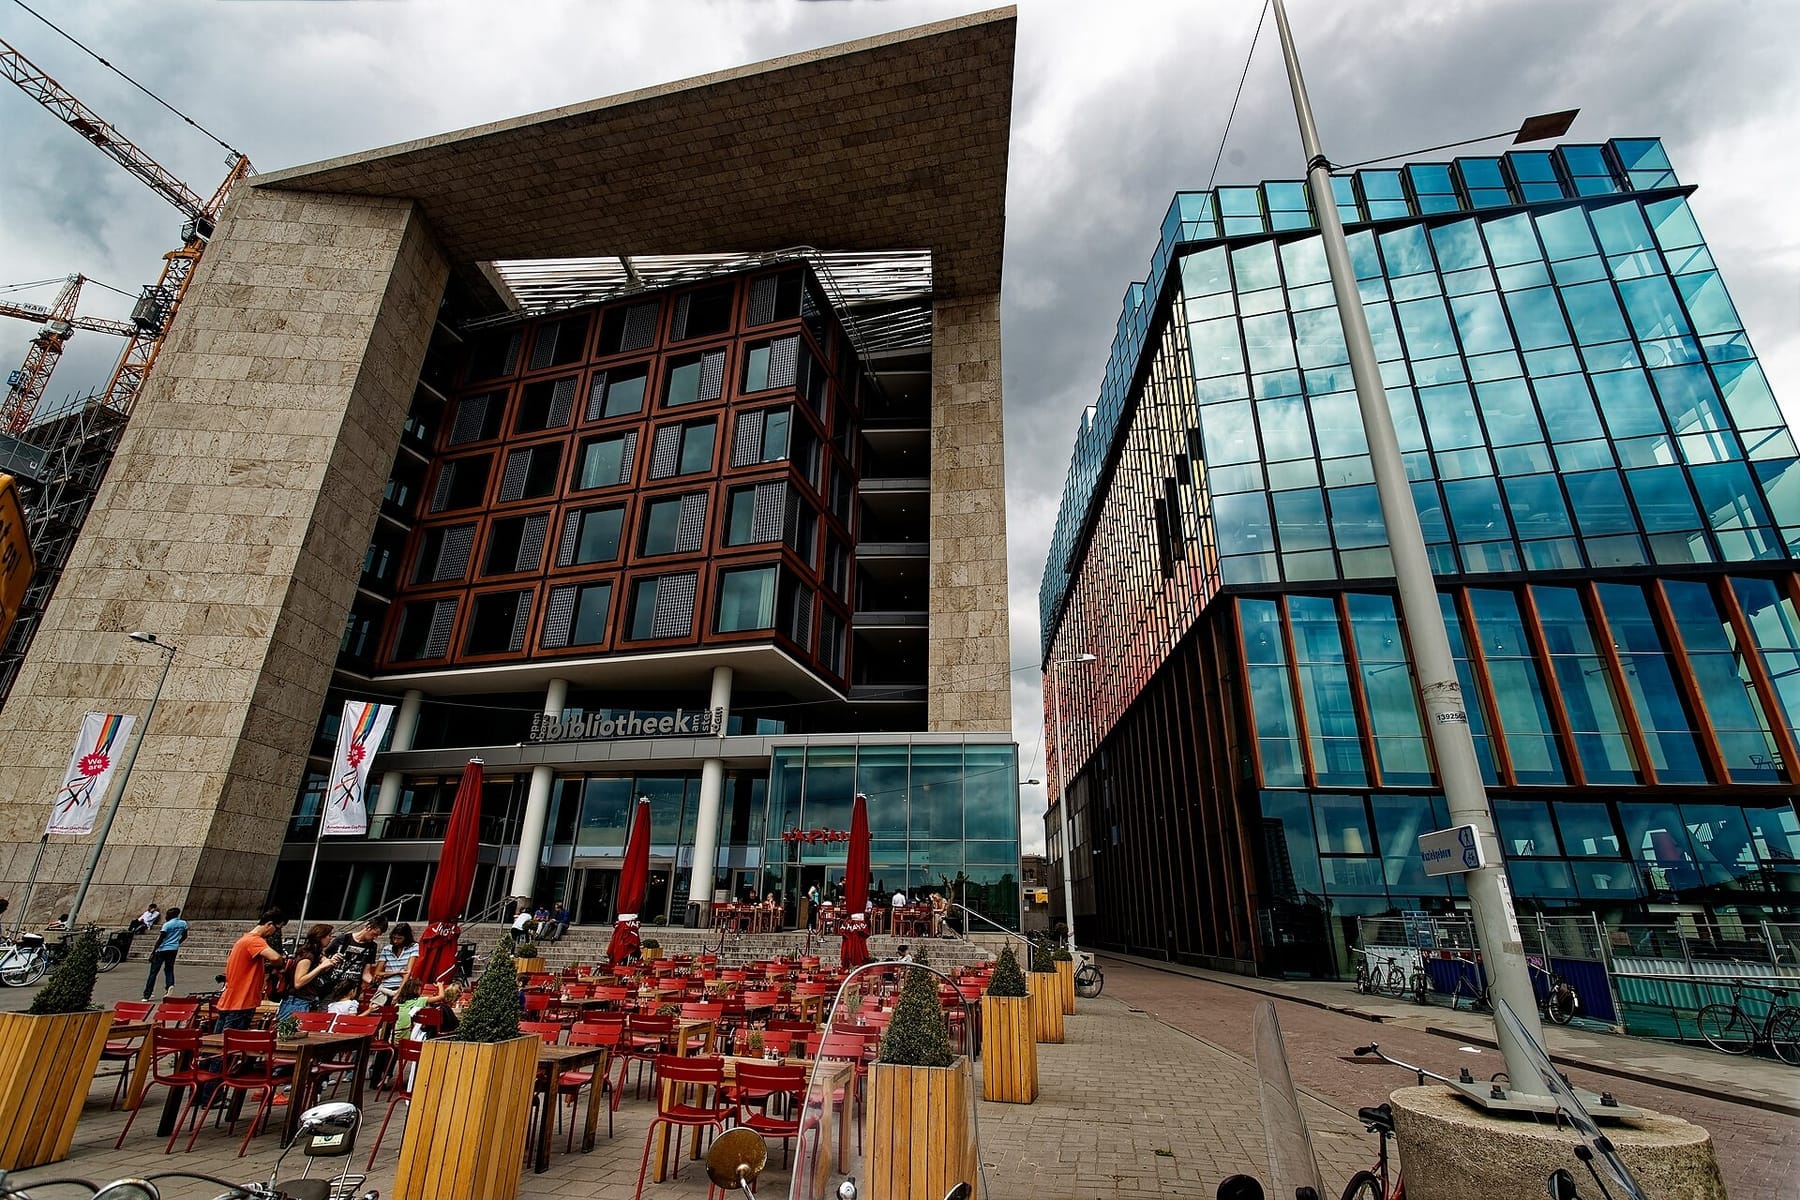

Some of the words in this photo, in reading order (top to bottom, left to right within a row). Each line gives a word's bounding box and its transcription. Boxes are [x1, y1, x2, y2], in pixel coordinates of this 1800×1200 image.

[529, 712, 541, 739] open
[547, 708, 691, 739] bibliotheek
[692, 714, 700, 732] am
[702, 708, 711, 732] ster
[781, 827, 874, 845] VAPIAN
